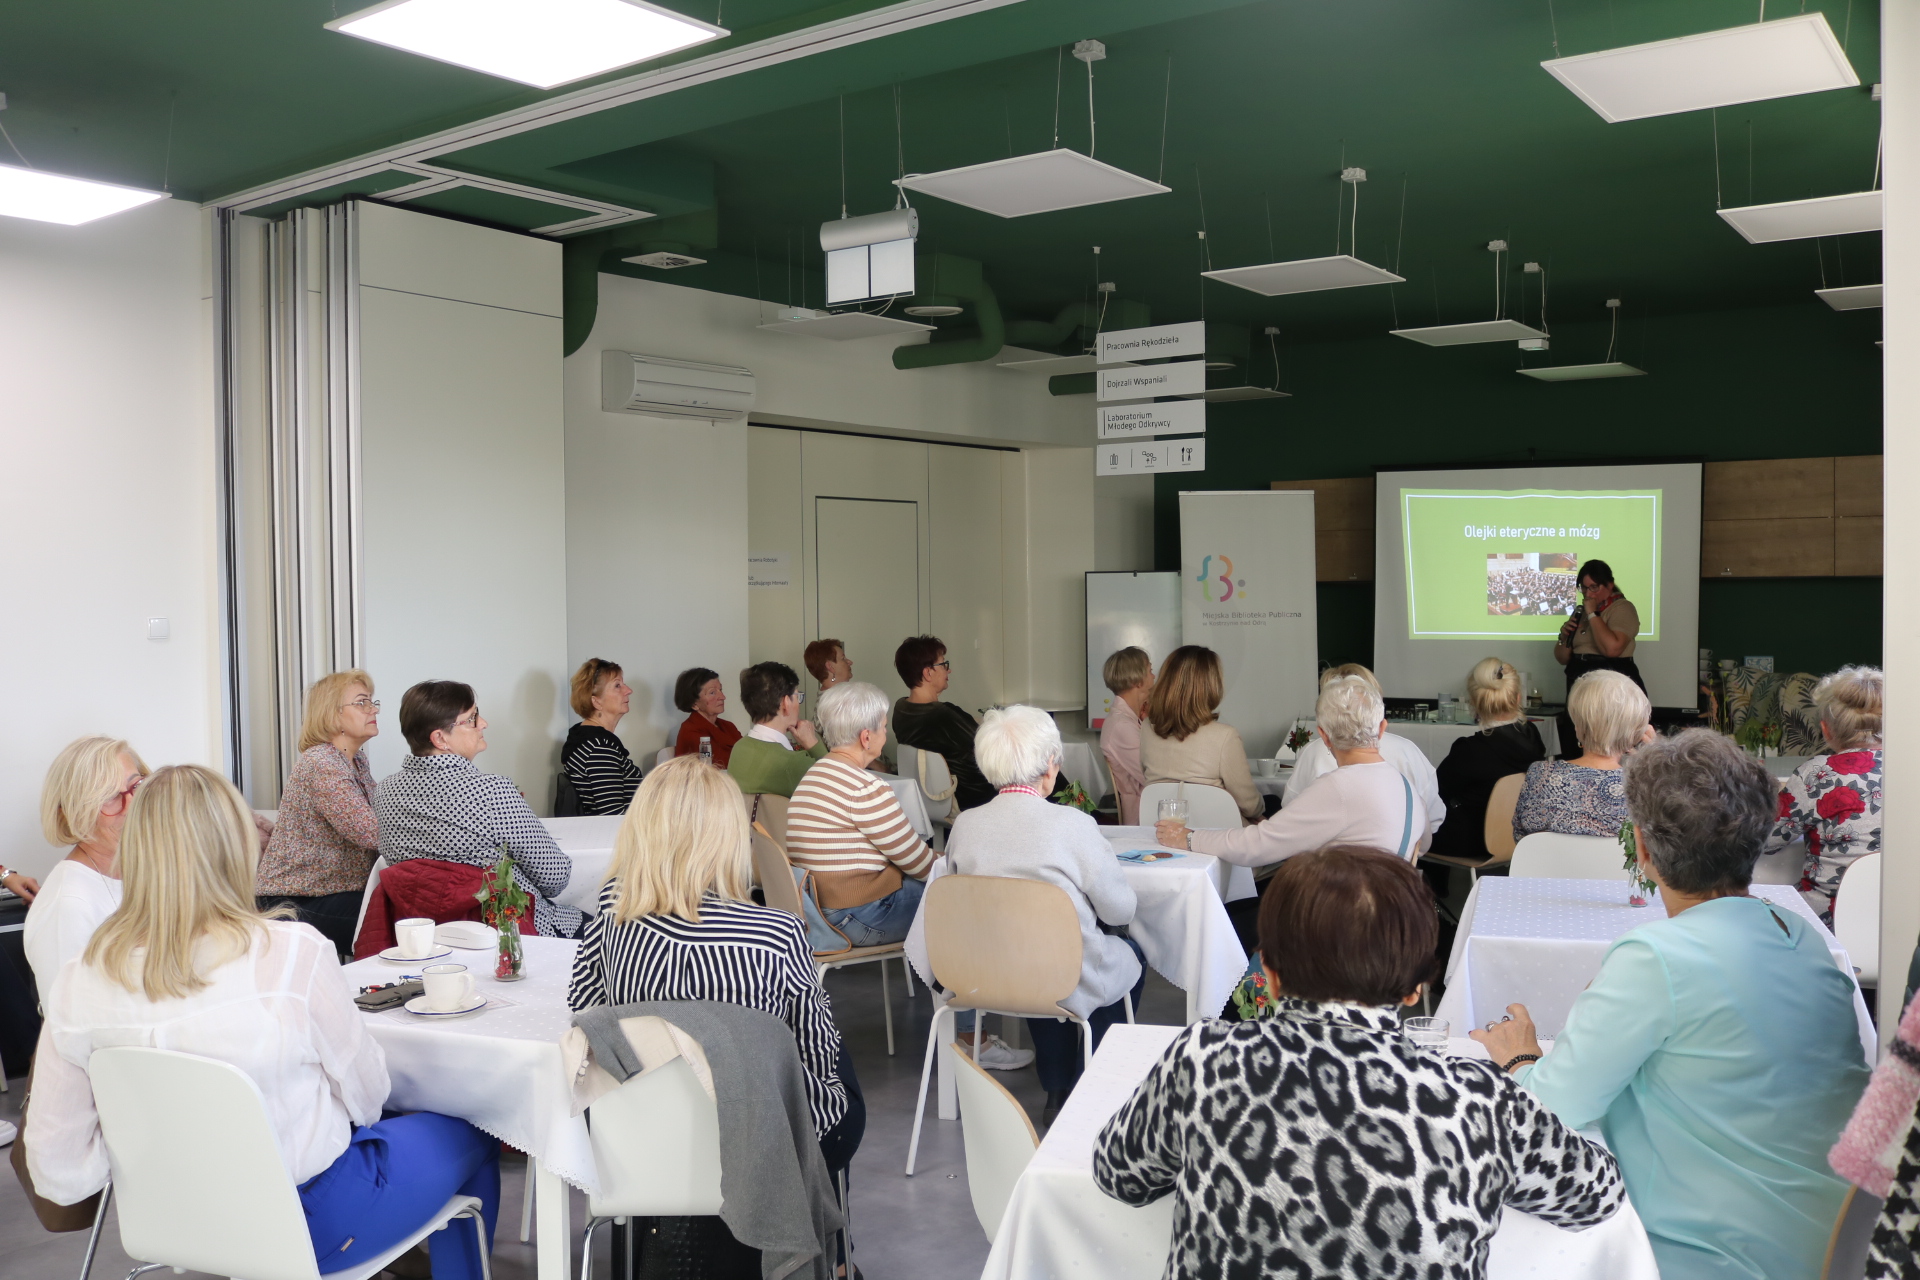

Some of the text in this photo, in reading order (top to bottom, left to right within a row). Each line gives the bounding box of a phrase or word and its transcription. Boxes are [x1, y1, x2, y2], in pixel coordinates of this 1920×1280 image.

[1106, 336, 1180, 351] Pracownia Rękodzieła
[1107, 375, 1168, 389] Dojrzali Wspaniali
[1107, 412, 1153, 422] Laboratorium
[1107, 419, 1171, 431] Młodego Odkrywcy
[1464, 524, 1600, 541] Olejki eteryczne a mózg
[1202, 612, 1230, 620] Miejska
[1231, 611, 1267, 619] Biblioteka
